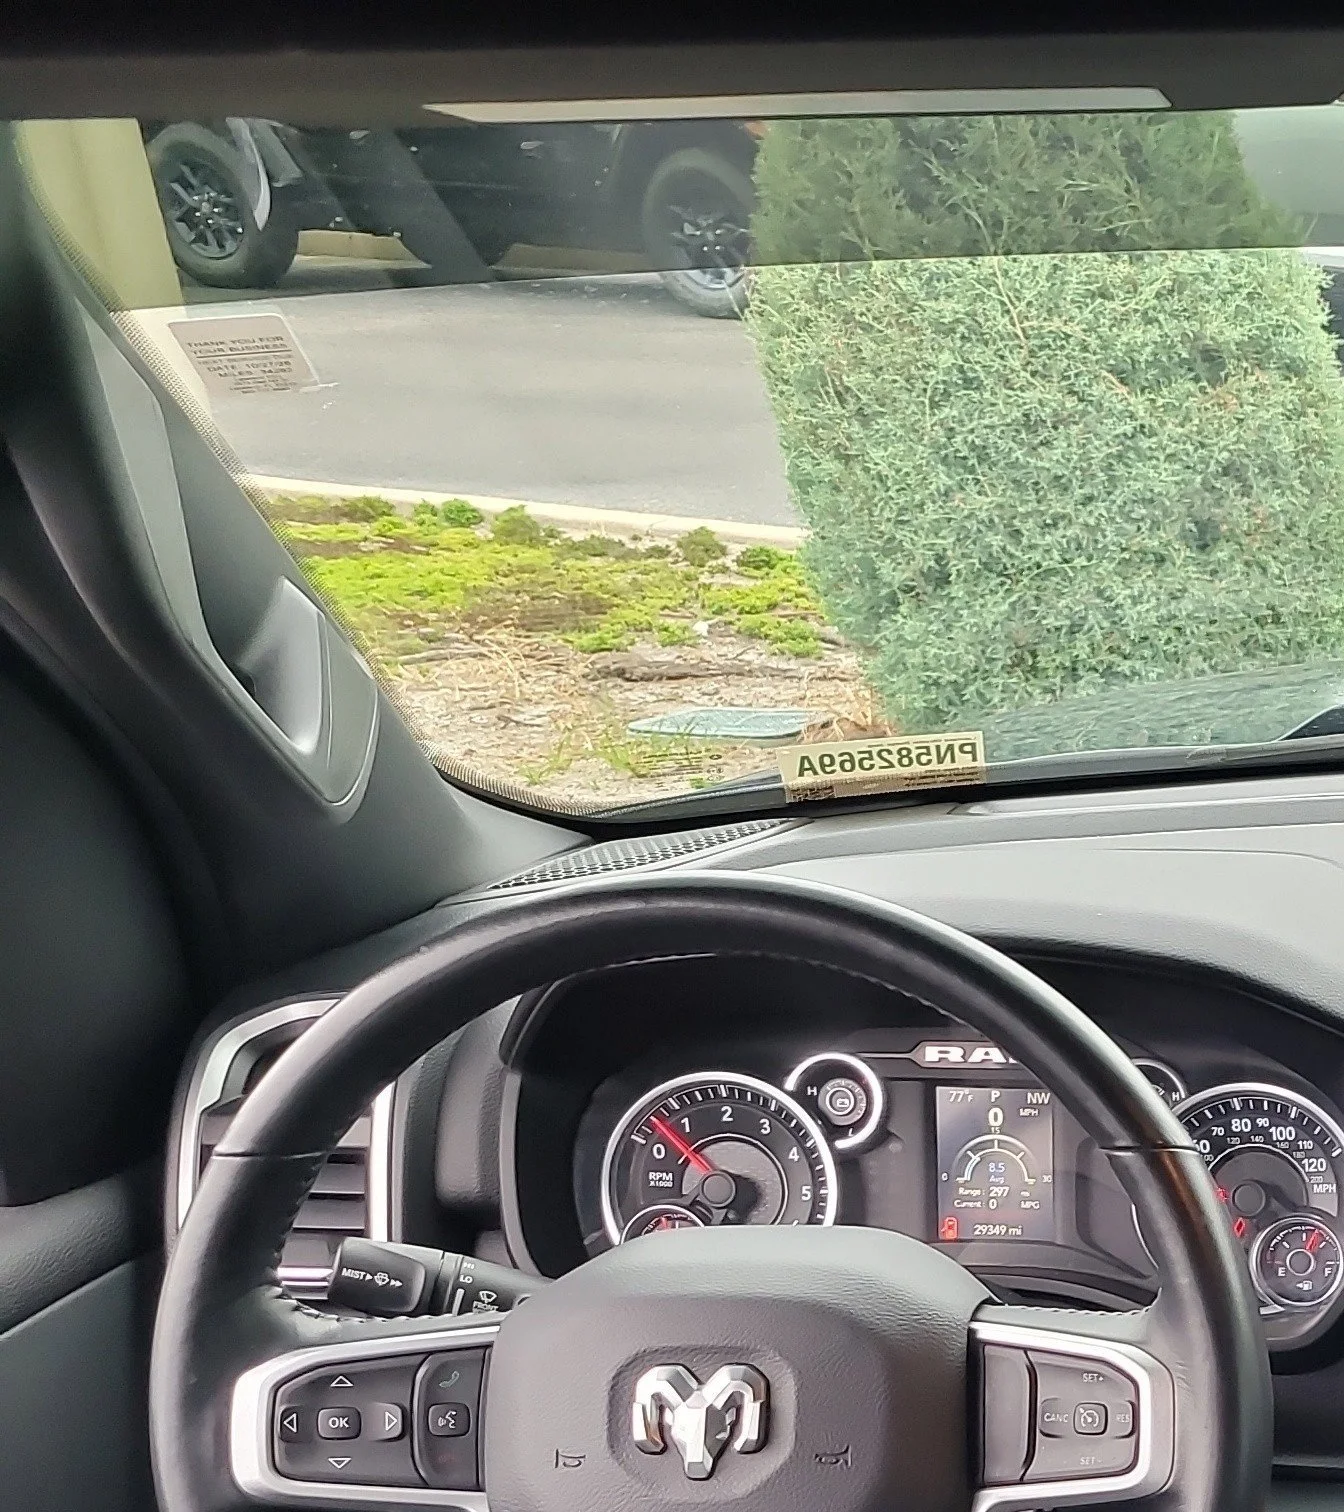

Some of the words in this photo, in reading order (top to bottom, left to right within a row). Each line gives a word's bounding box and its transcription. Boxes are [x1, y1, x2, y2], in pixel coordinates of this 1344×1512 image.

[924, 1046, 1019, 1064] RA
[806, 1085, 818, 1096] H
[991, 1090, 1001, 1102] P
[1172, 1092, 1180, 1101] H
[1027, 1092, 1051, 1104] NW
[720, 1105, 734, 1122] 2
[988, 1107, 1004, 1127] 0
[1019, 1108, 1039, 1116] MPH
[680, 1117, 692, 1133] 1
[760, 1118, 772, 1135] 3
[1231, 1118, 1252, 1132] 80
[1256, 1118, 1270, 1128] 90
[1211, 1126, 1225, 1136] 70
[1269, 1126, 1296, 1141] 100
[652, 1143, 666, 1159] 0
[1297, 1140, 1314, 1150] 110
[788, 1146, 800, 1163] 4
[988, 1162, 1005, 1173] 8.5
[1302, 1158, 1327, 1172] 120
[649, 1172, 673, 1182] RPM
[801, 1185, 811, 1201] 5
[989, 1186, 1010, 1197] 297
[1313, 1183, 1337, 1193] MPH
[988, 1199, 998, 1210] 0
[1020, 1200, 1040, 1209] MPG
[973, 1224, 1007, 1236] 29349
[1008, 1225, 1022, 1236] mi
[341, 1267, 366, 1280] MIST
[1277, 1267, 1286, 1278] E
[1324, 1266, 1332, 1278] F
[459, 1274, 473, 1284] LO
[328, 1416, 350, 1430] OK
[1043, 1413, 1069, 1423] CANC
